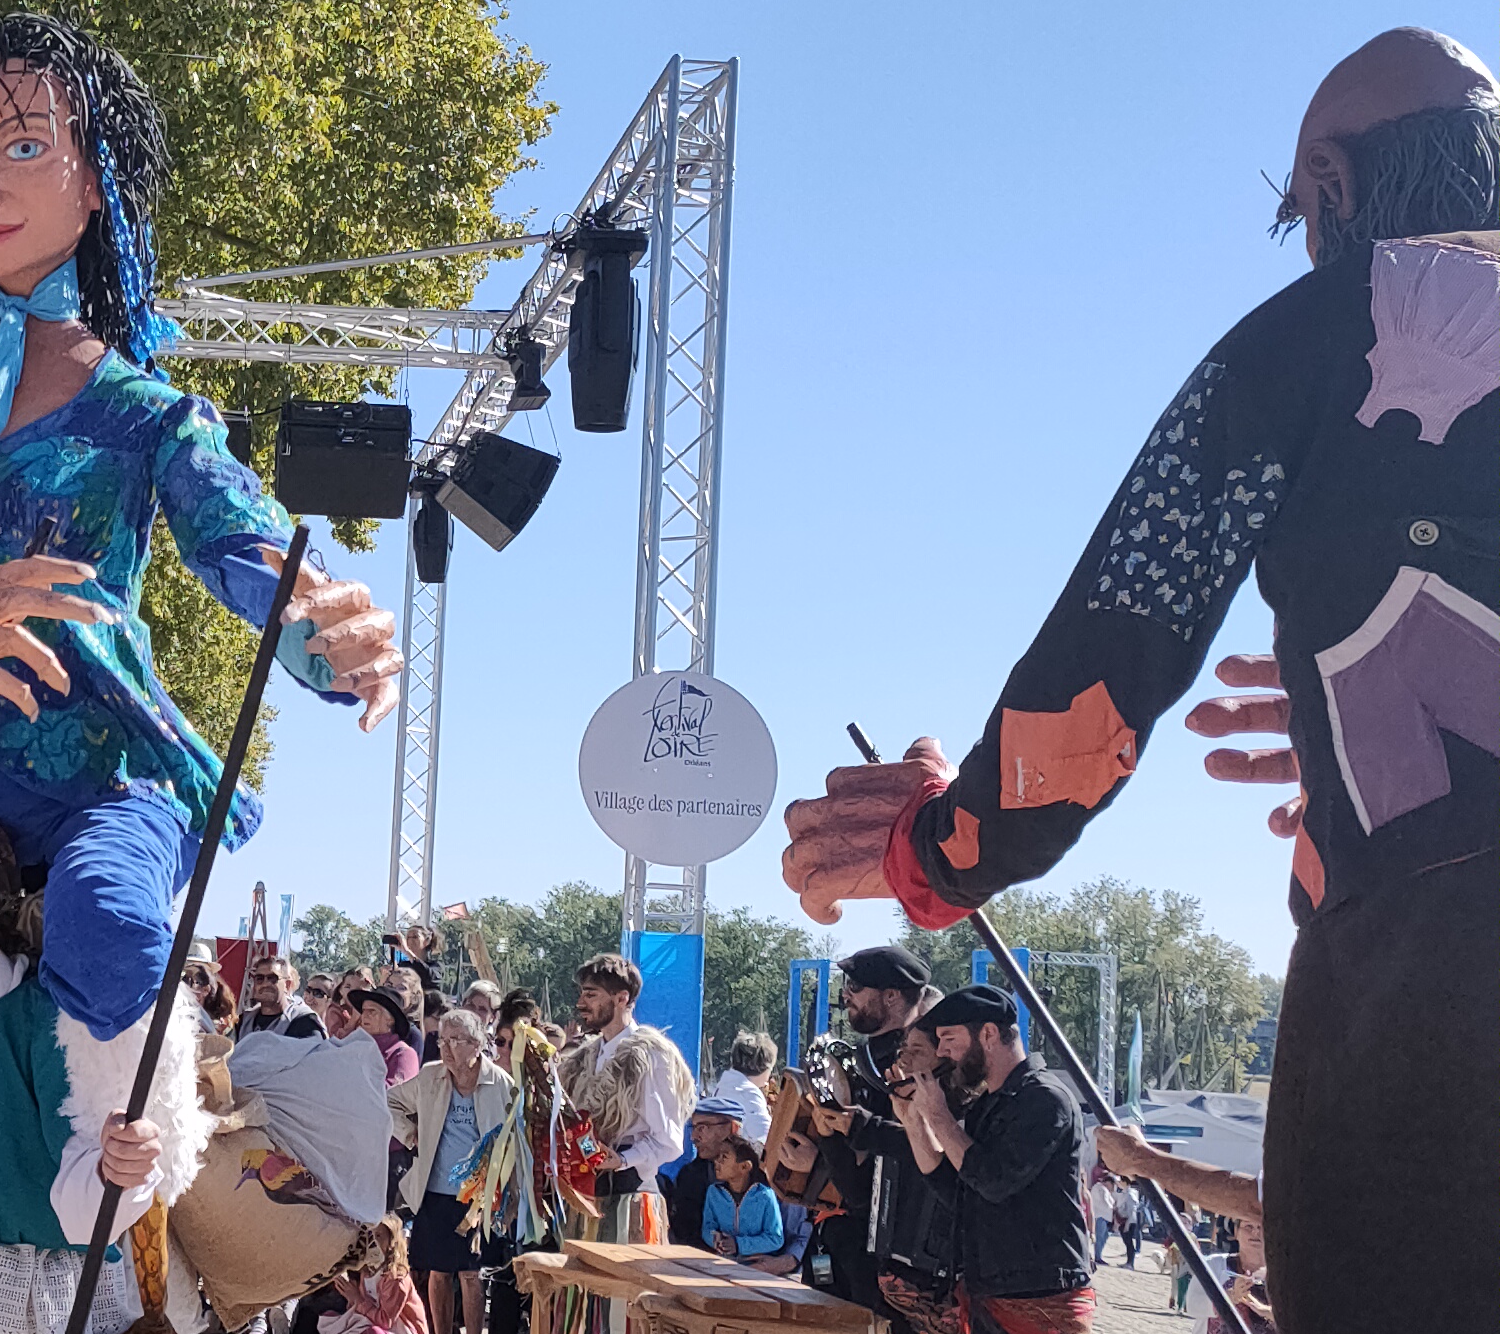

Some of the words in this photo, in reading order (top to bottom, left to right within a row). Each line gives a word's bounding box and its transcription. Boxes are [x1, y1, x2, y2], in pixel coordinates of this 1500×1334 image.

[594, 790, 645, 815] Village
[648, 794, 673, 813] des
[677, 798, 762, 818] partenaires
